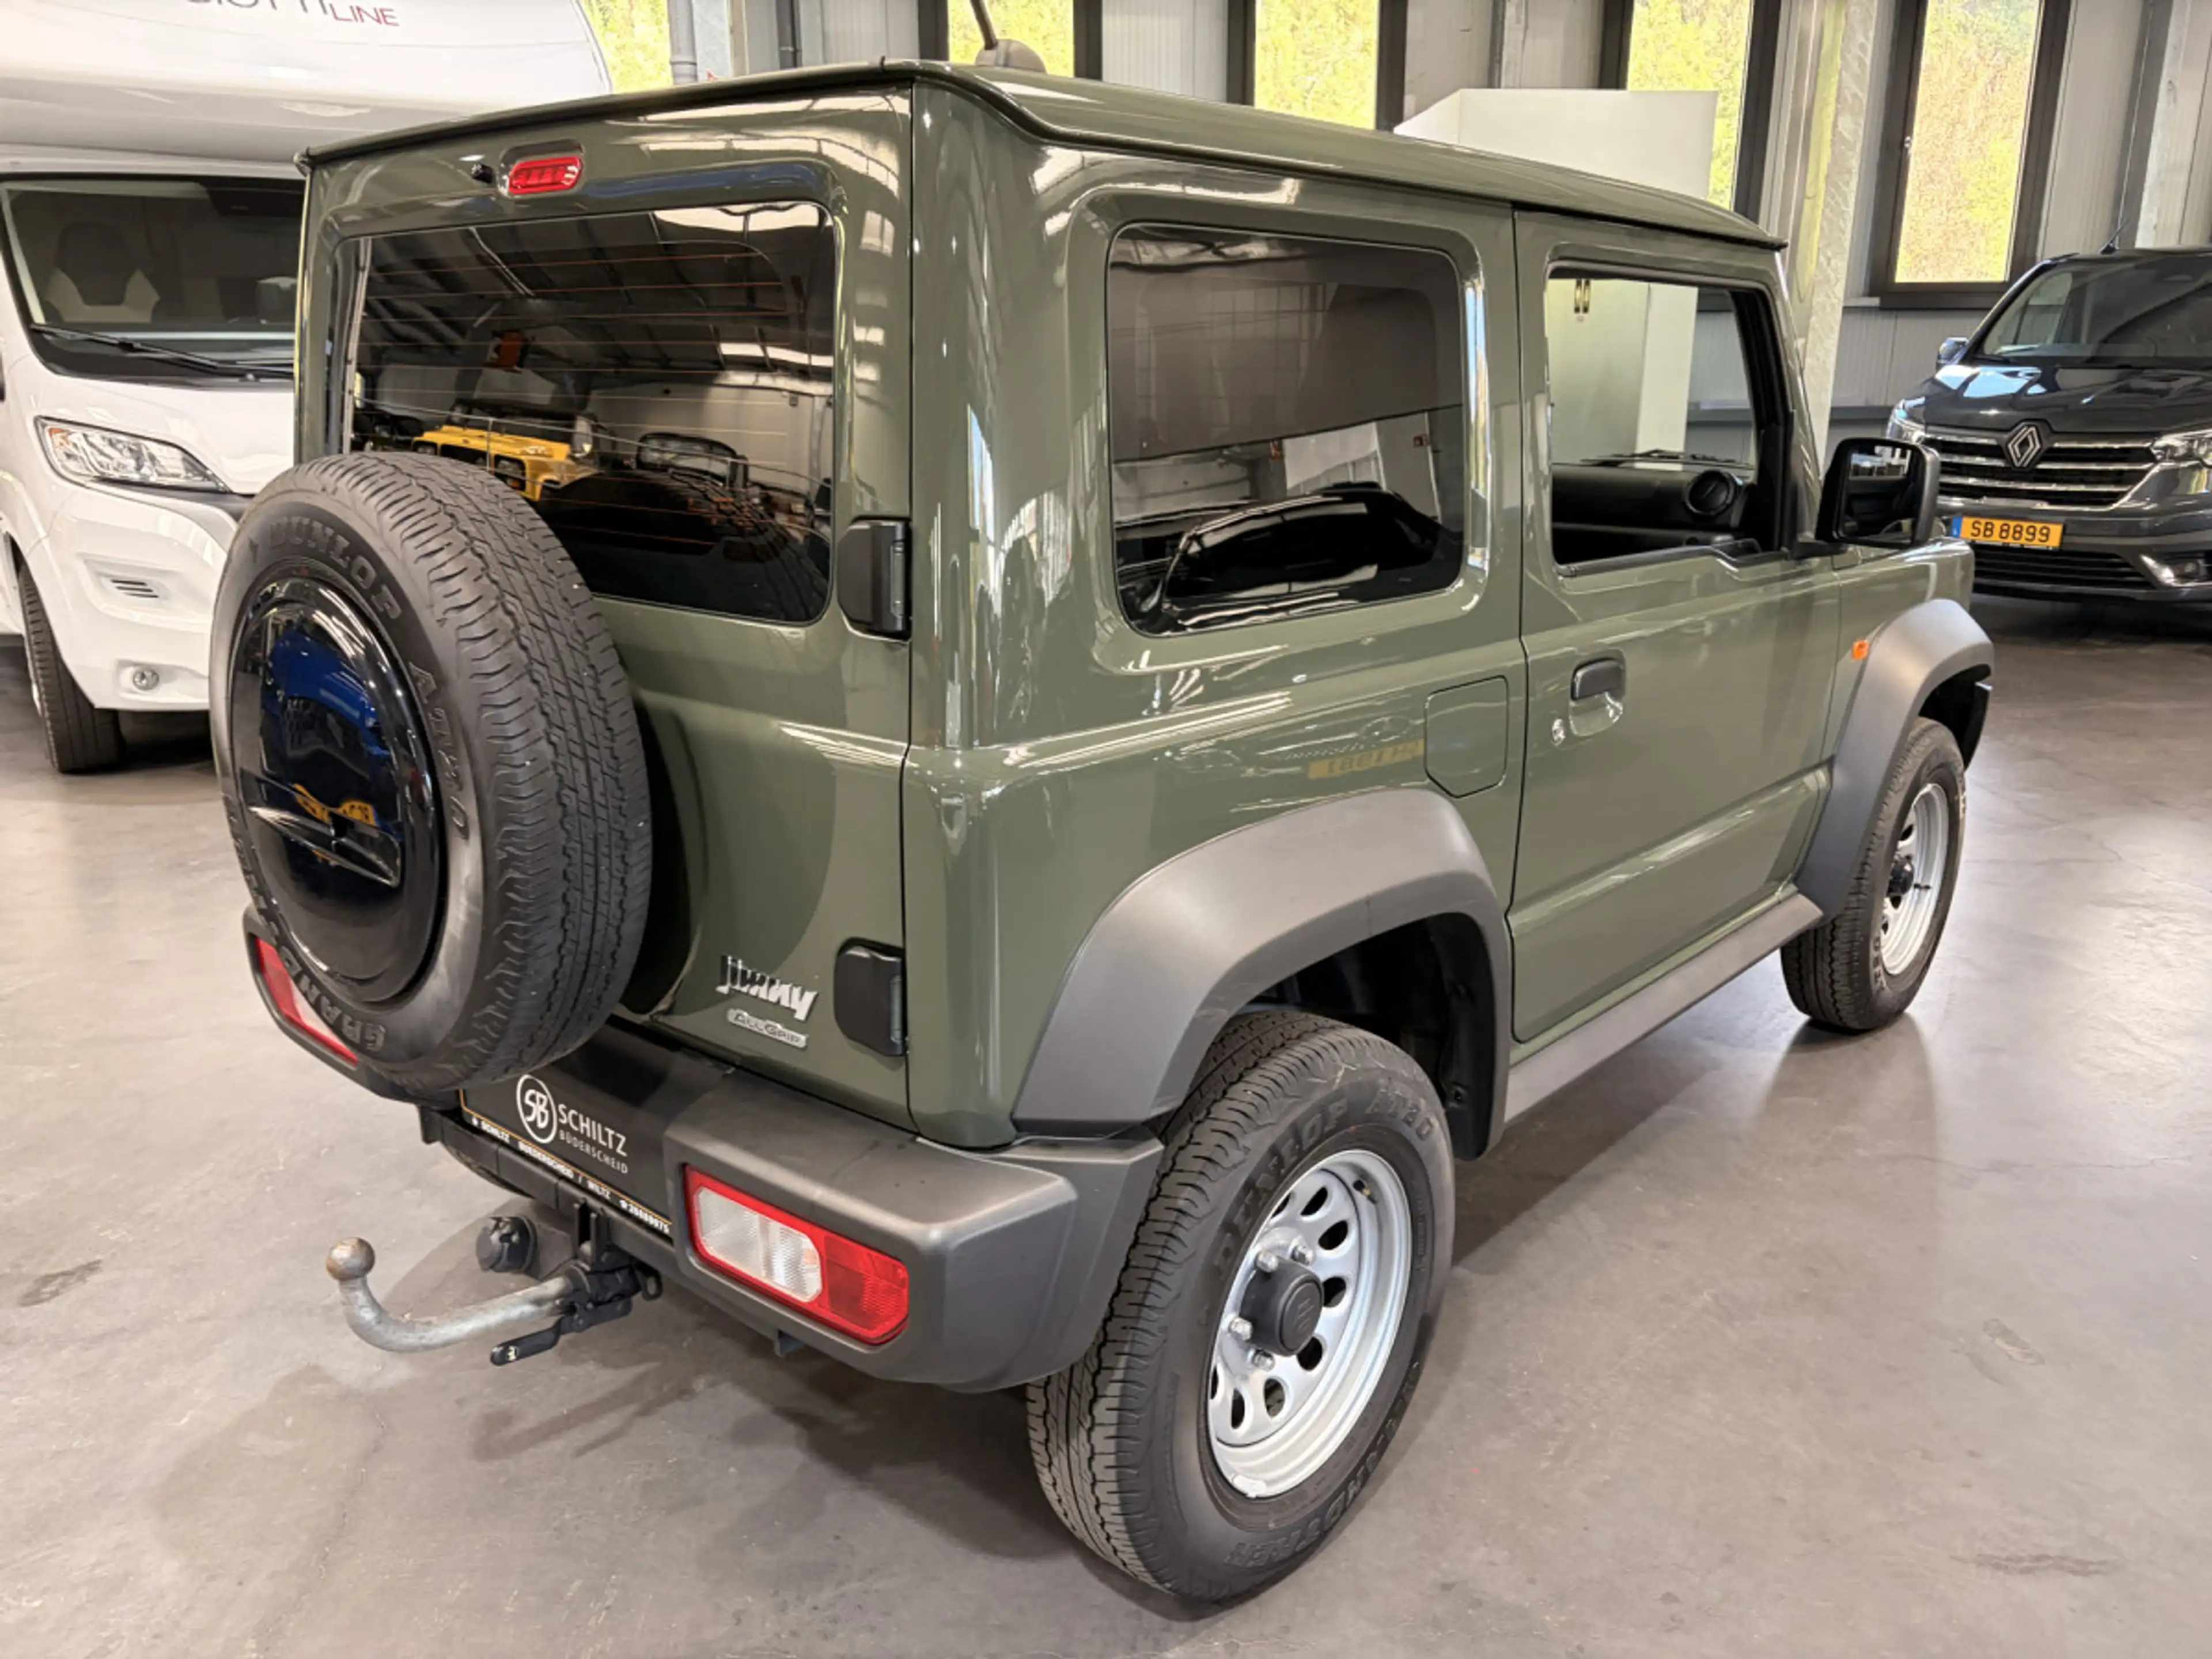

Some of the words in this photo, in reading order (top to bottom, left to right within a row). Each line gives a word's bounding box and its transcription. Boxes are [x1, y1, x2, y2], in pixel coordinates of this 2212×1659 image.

[329, 3, 399, 26] LINE
[1971, 520, 1994, 538] SB
[1999, 523, 2050, 543] 8899
[267, 515, 403, 620] DUNLOP
[558, 1104, 628, 1157] SCHILTZ
